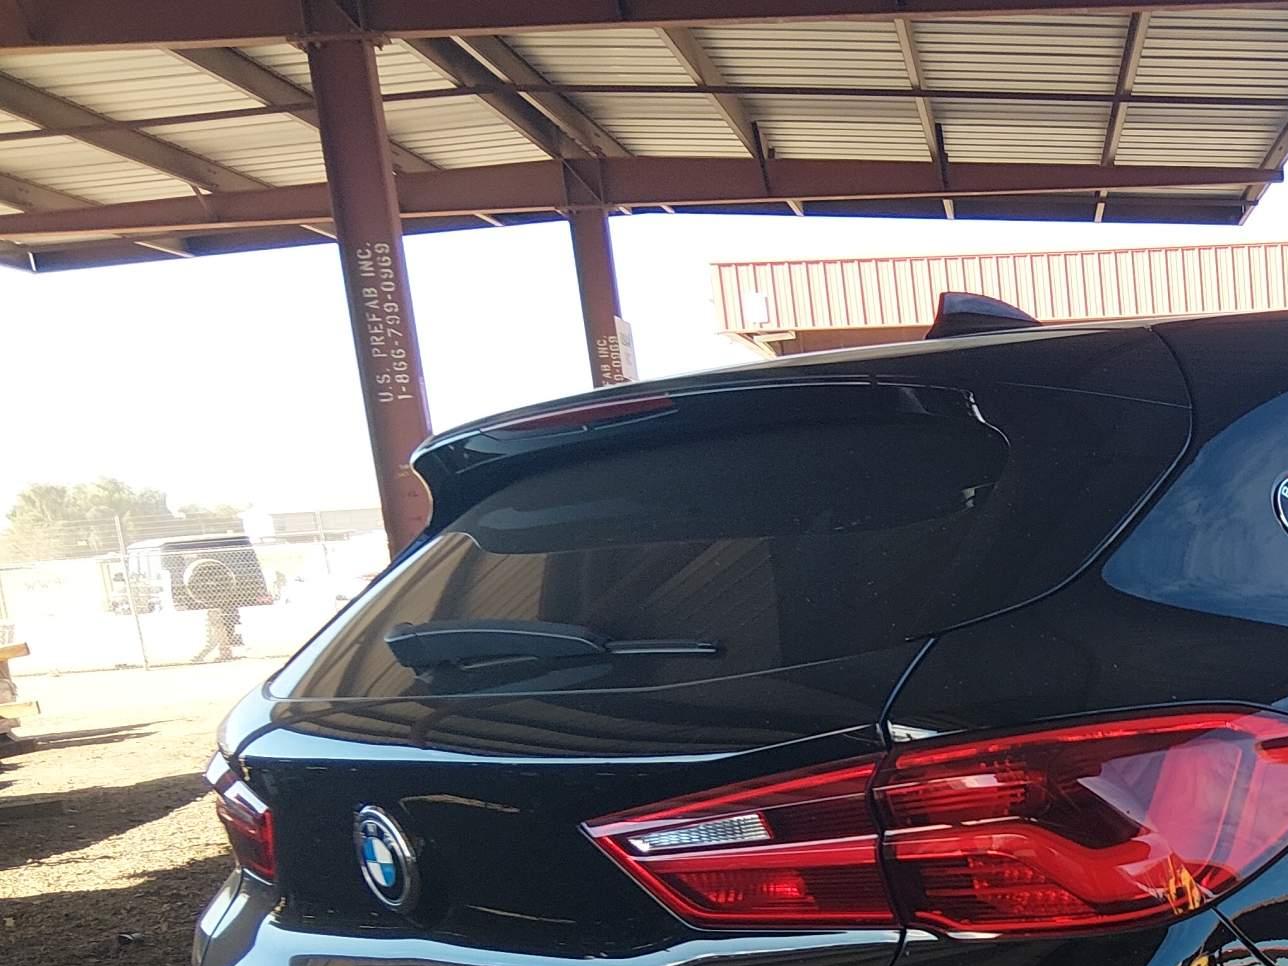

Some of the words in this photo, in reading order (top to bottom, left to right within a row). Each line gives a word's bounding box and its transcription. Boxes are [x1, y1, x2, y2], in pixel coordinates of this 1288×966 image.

[356, 242, 376, 277] INC.
[362, 286, 388, 358] PREFAB
[374, 242, 414, 400] 1-866-799-0969
[375, 368, 394, 402] U.S.
